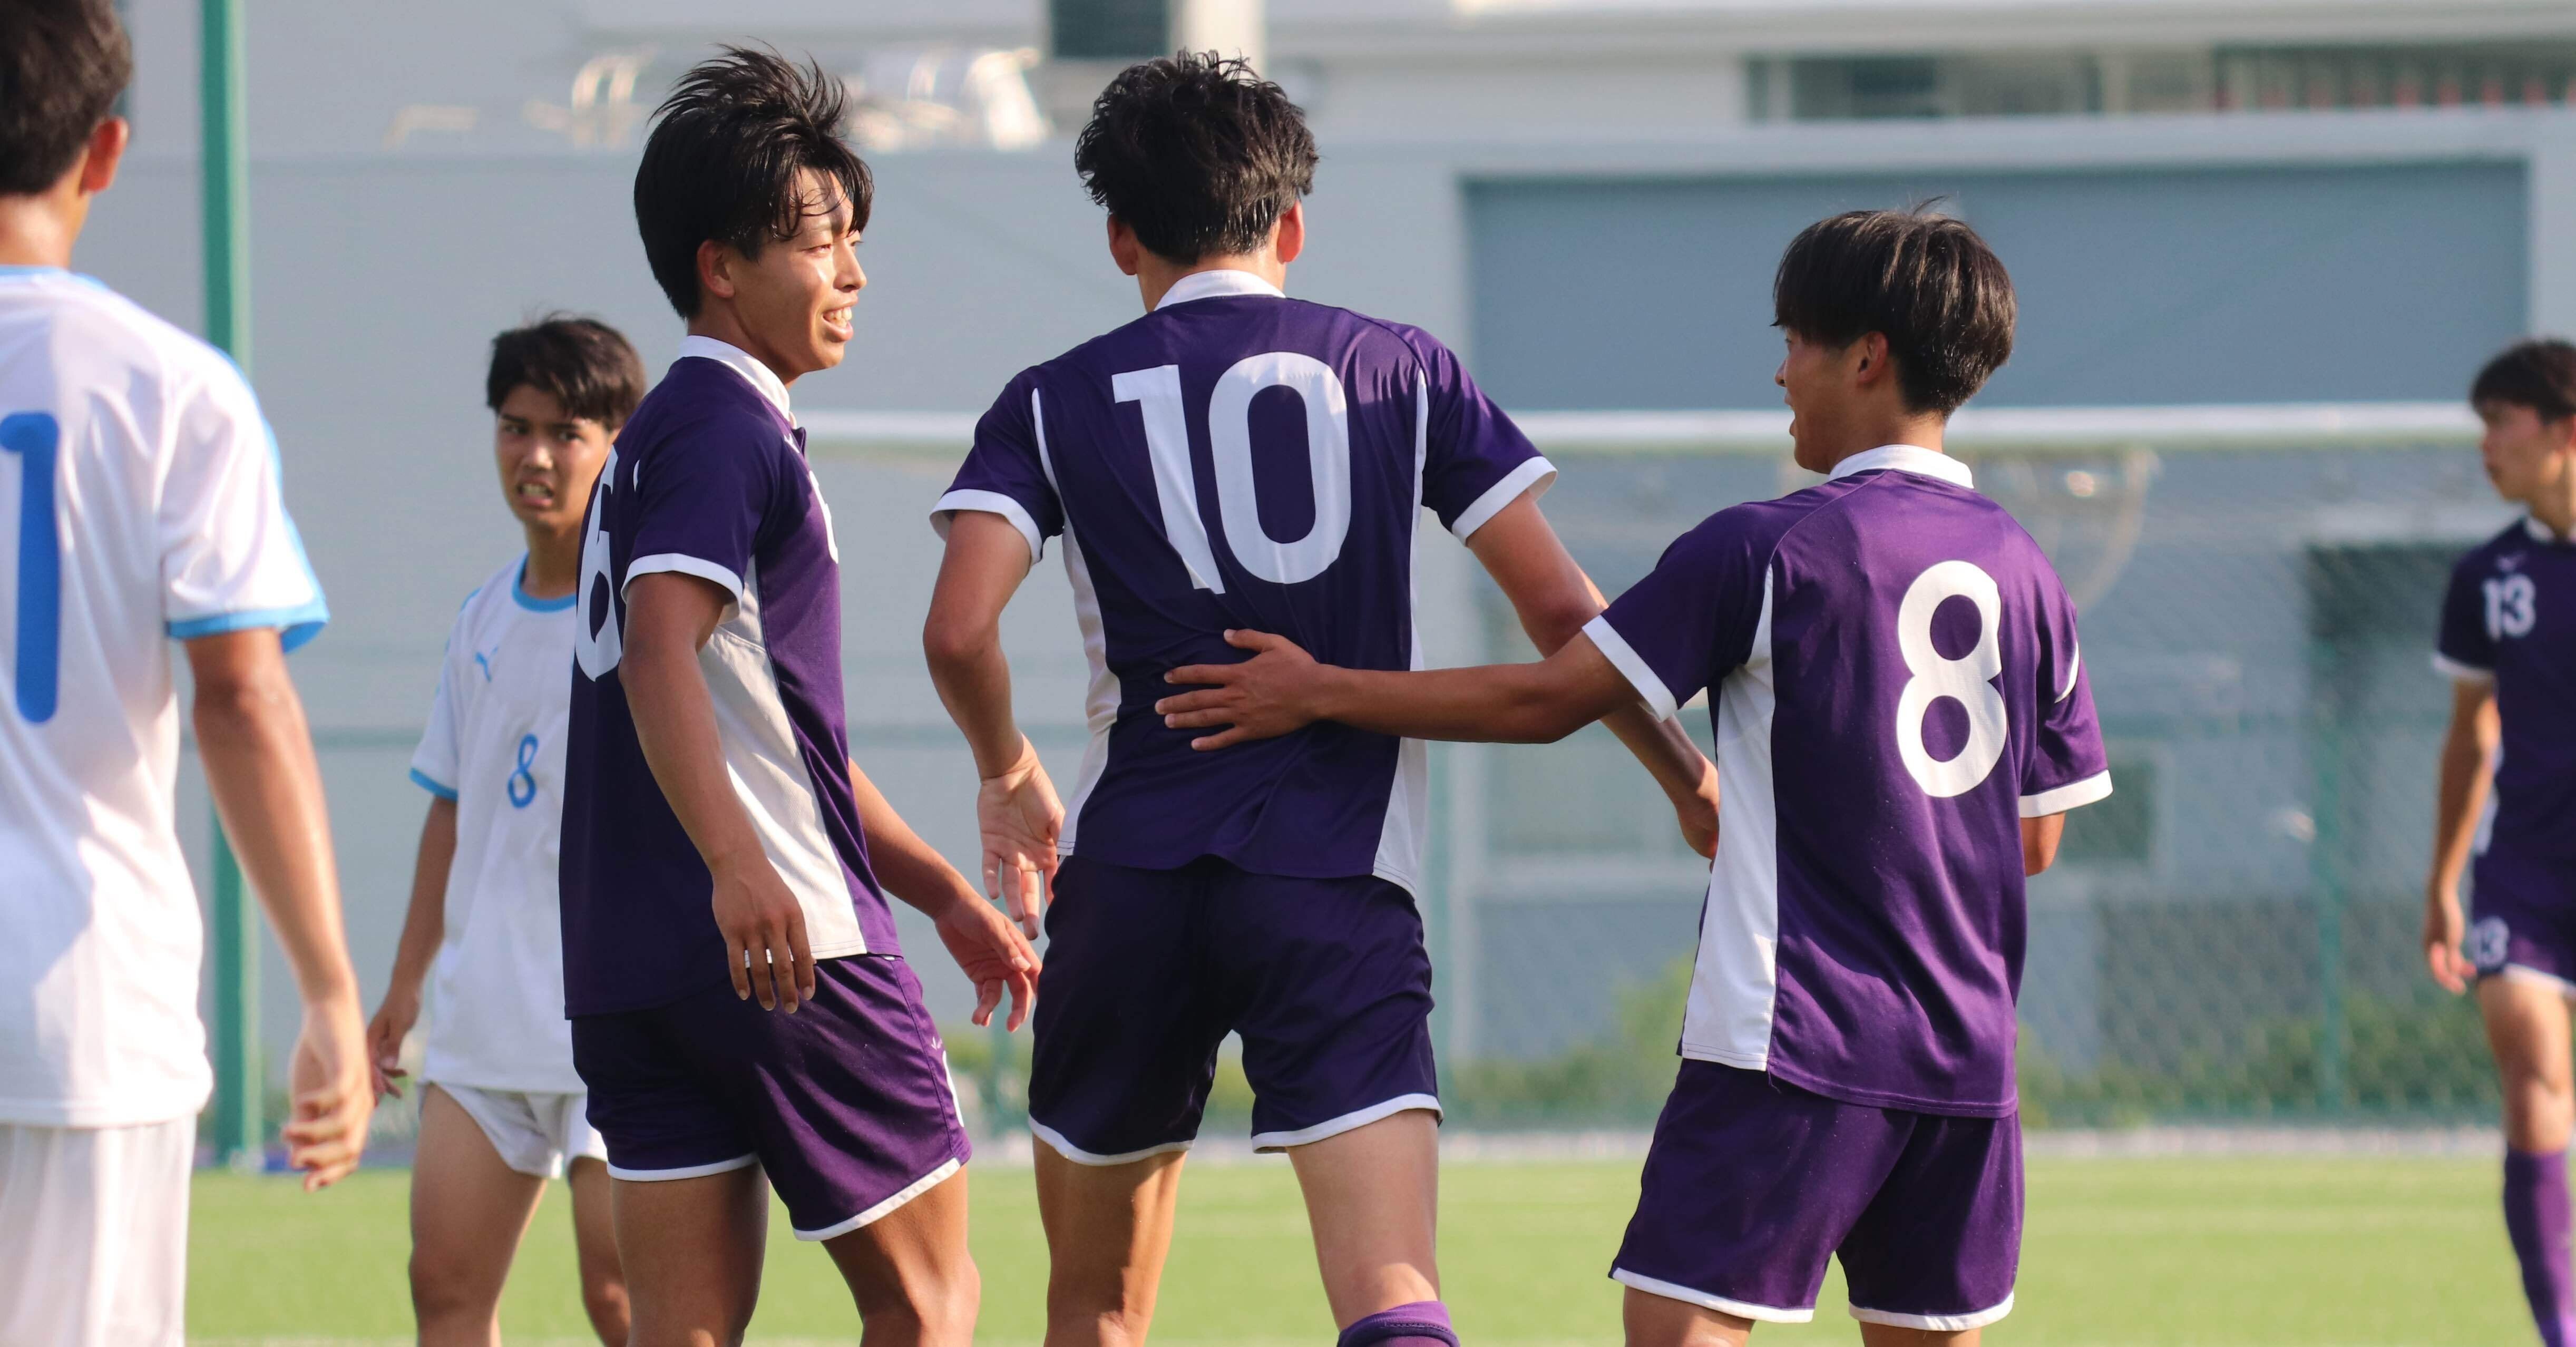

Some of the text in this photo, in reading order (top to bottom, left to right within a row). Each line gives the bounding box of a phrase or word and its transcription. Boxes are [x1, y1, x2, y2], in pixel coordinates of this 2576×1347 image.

[0, 413, 58, 724] 1
[575, 444, 623, 682] 6
[1112, 351, 1351, 594] 10
[1896, 560, 2008, 798] 8
[2481, 573, 2536, 641] 13
[508, 733, 538, 809] 8
